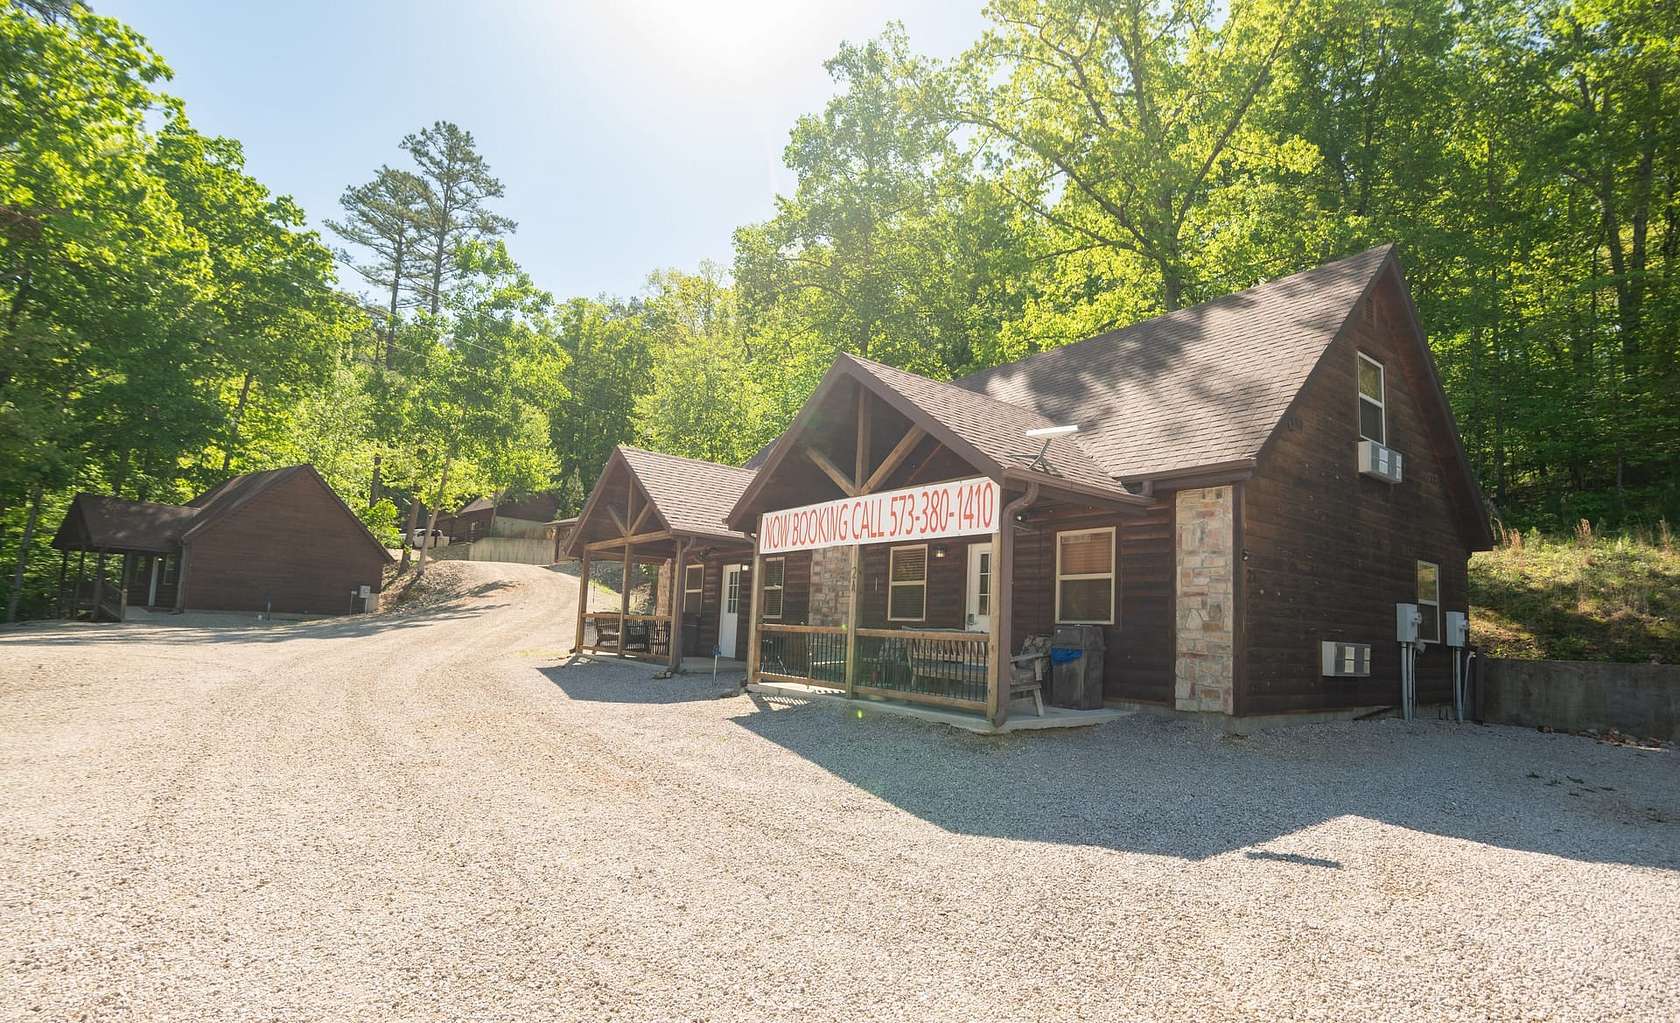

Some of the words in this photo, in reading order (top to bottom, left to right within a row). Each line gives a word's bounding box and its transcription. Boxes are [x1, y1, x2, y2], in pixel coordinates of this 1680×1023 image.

[764, 514, 791, 549] NOW
[792, 503, 849, 546] BOOKING
[852, 498, 885, 539] CALL
[889, 482, 993, 536] 573-380-1410
